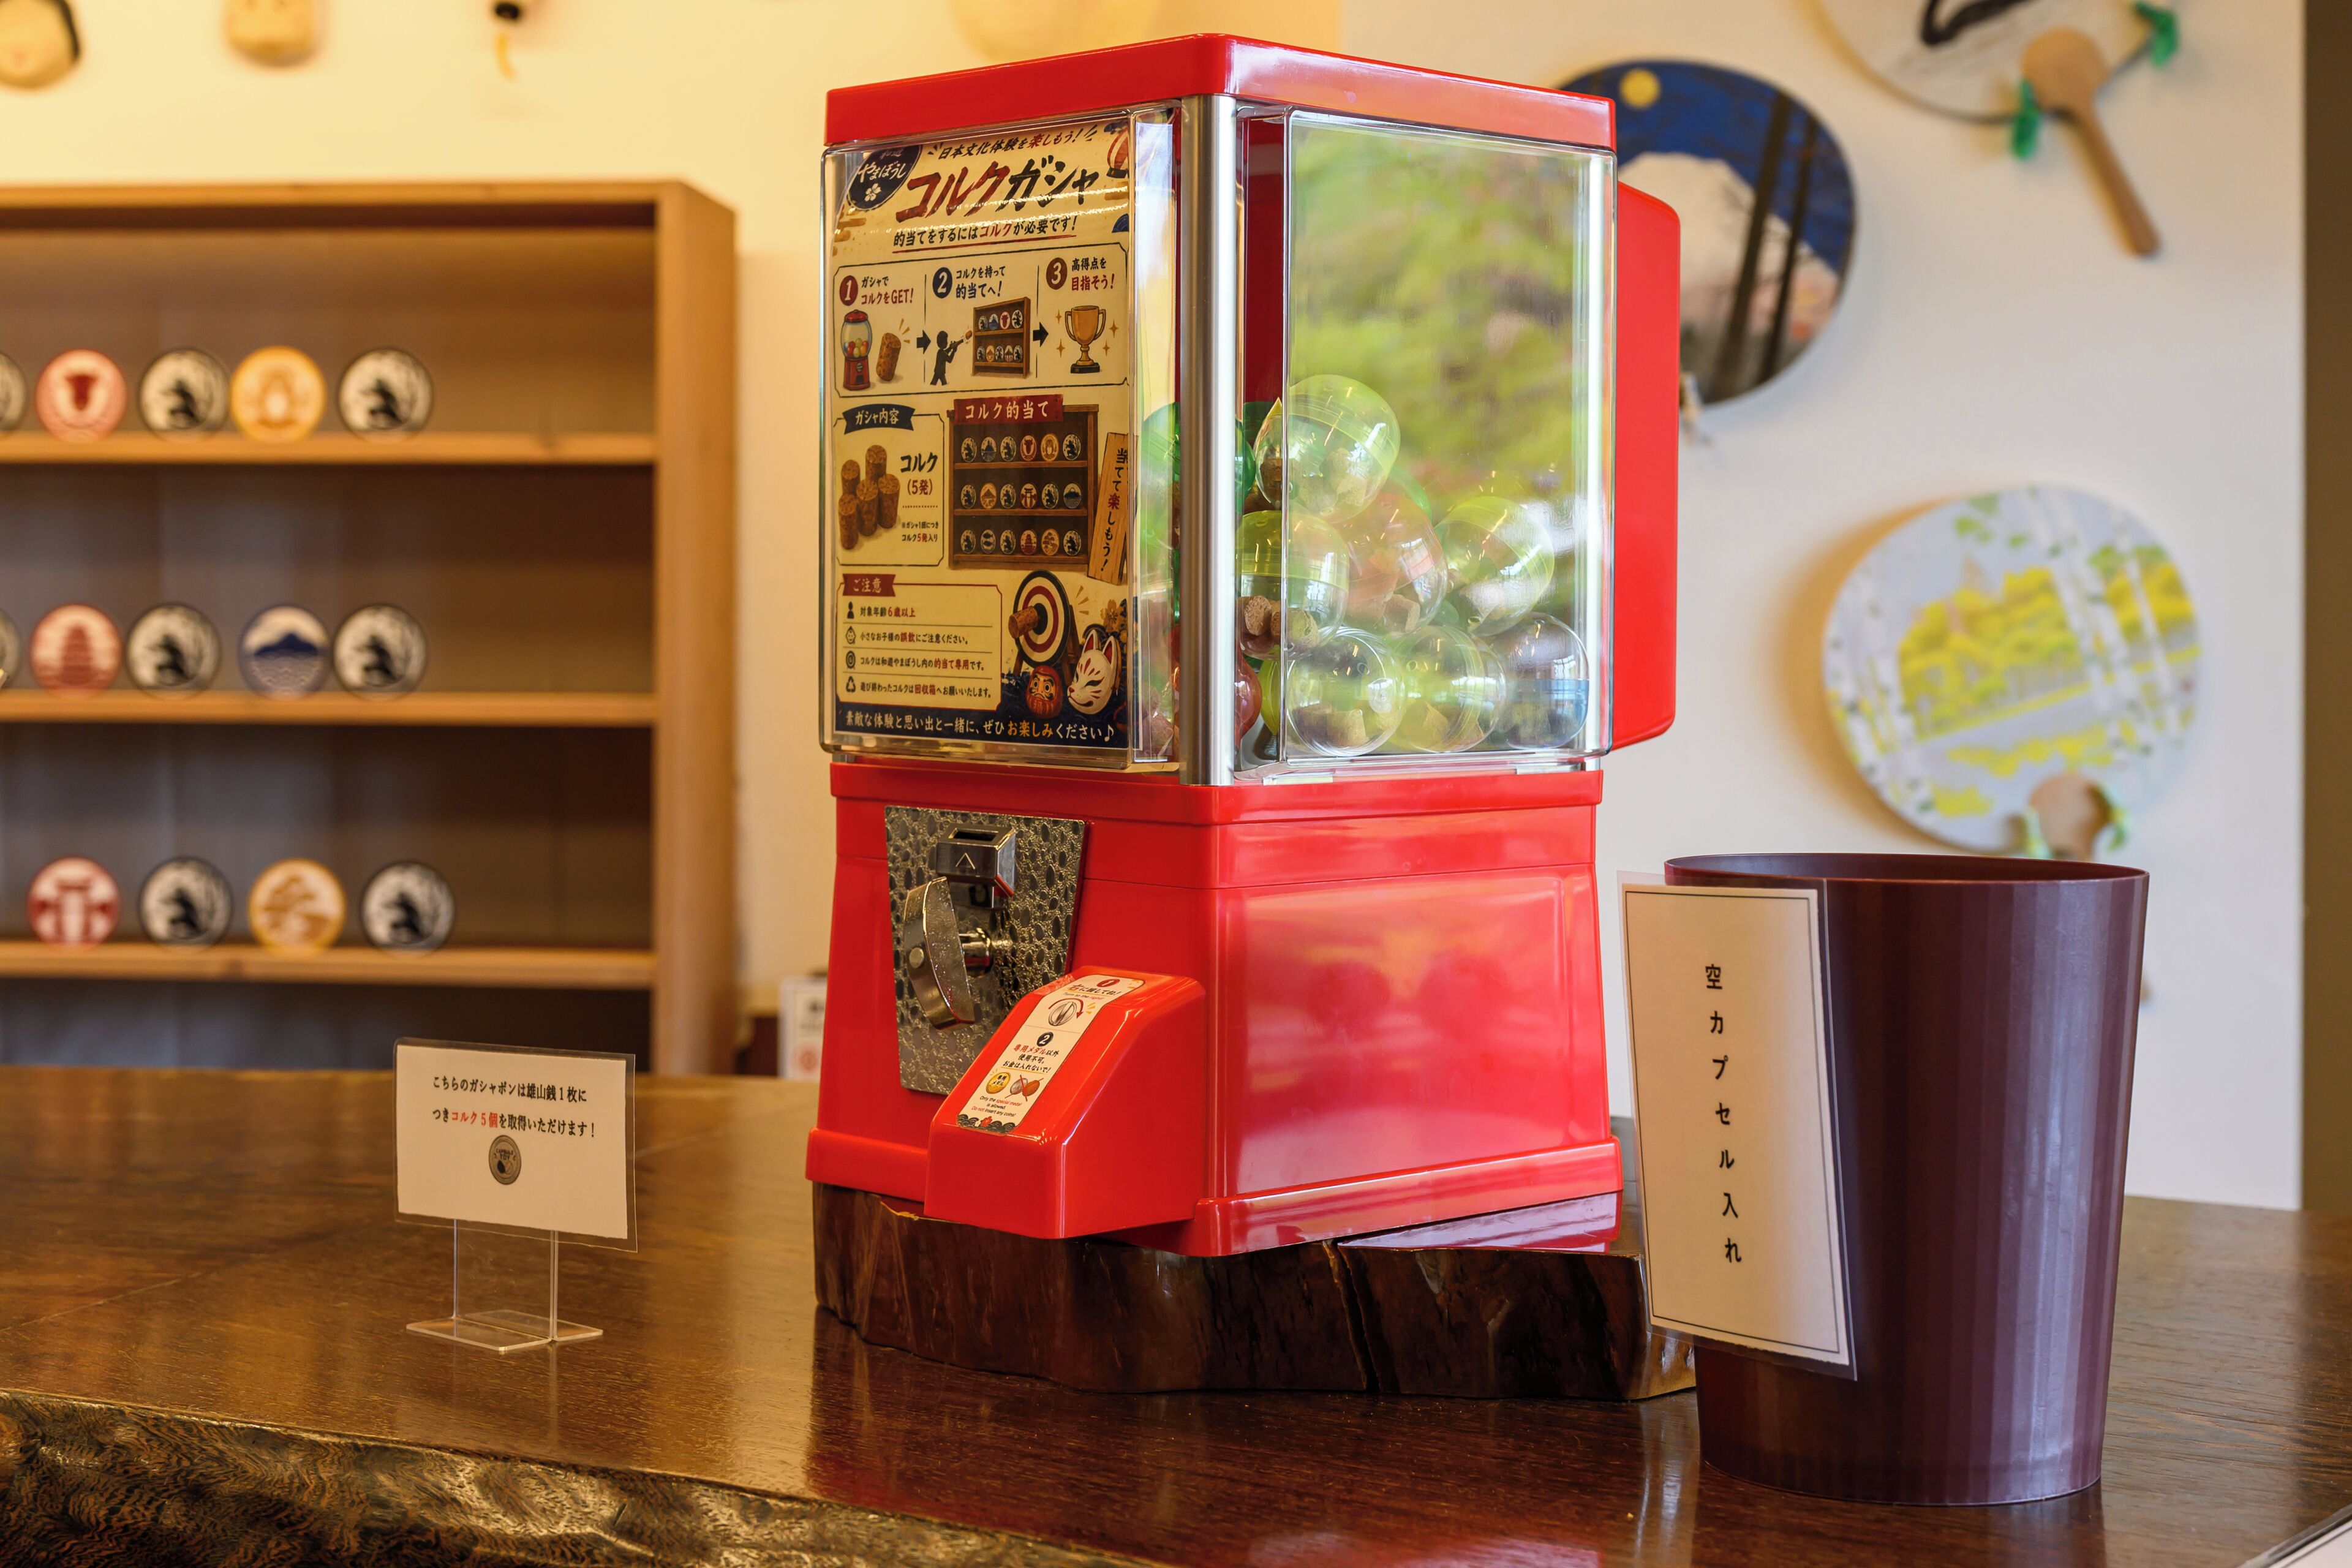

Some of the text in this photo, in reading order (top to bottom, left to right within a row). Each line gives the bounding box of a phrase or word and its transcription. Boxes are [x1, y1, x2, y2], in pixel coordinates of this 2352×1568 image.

[938, 128, 1083, 159] 日本文化体験を楽しもう!
[858, 161, 907, 183] やまぼうし
[895, 155, 1099, 222] コルクガシャ
[894, 216, 1076, 247] 的当てをするにはコルクが必要です!
[956, 265, 1006, 280] コルクを持って
[1071, 257, 1106, 271] 高得点を
[862, 276, 889, 288] ガシャで
[956, 281, 1001, 299] 的当てへ!
[1071, 274, 1115, 291] 目指そう!
[861, 288, 913, 304] コルクをGET!
[856, 409, 899, 426] ガシャ内容
[965, 400, 1048, 420] コルク的当て
[900, 452, 938, 473] コルク
[908, 478, 932, 495] (5発)
[1101, 448, 1128, 571] 当てて楽しもう!
[902, 533, 938, 542] コルク5発入り
[853, 578, 881, 593] ご注意
[860, 606, 916, 617] 対象年齢6歳以上
[861, 632, 968, 644] 小さなお子様の誤飲にご注意ください。
[1014, 1044, 1059, 1057] 専用メダル以外
[1003, 1060, 1051, 1073] お金は入れないで!
[432, 1107, 594, 1137] つきコルク5個を取得いただけます!
[1705, 963, 1742, 1264] 空カプセル入れ
